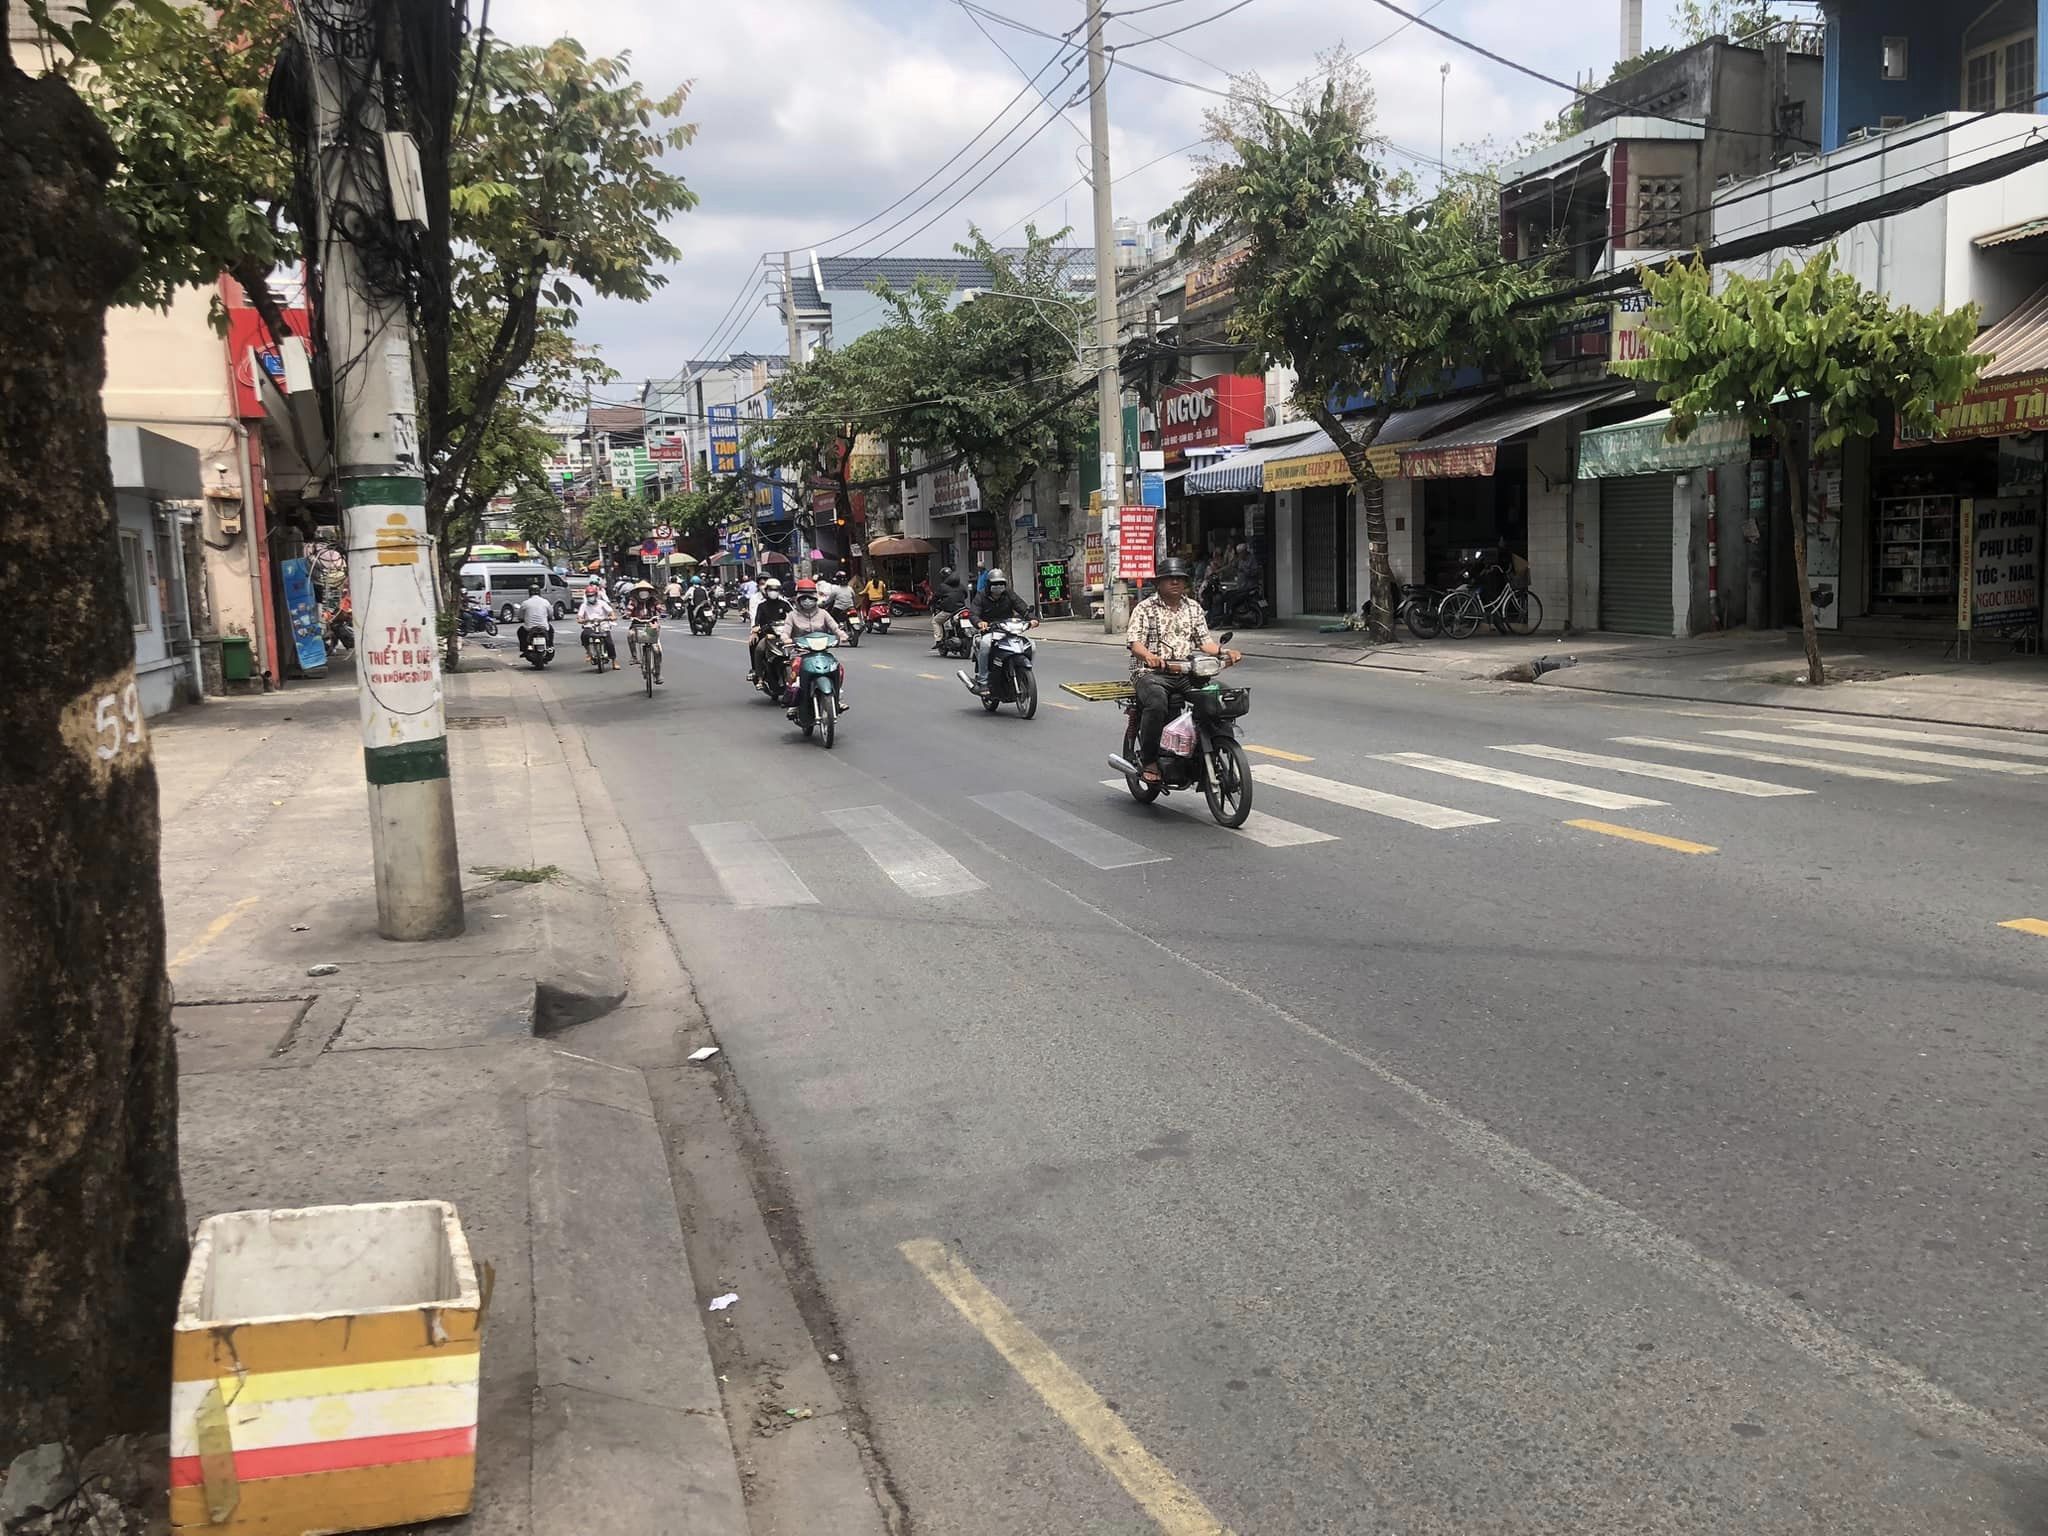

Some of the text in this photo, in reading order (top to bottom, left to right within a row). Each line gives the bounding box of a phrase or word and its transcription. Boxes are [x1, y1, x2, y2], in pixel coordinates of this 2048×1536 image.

[1167, 387, 1215, 426] NGỌC
[1940, 397, 2008, 431] MINH
[1979, 534, 2033, 560] PHỤ LIỆU
[1976, 565, 1998, 586] TÓC
[368, 644, 399, 666] THIẾT
[416, 646, 432, 668] ĐIỆ
[96, 682, 140, 760] 59
